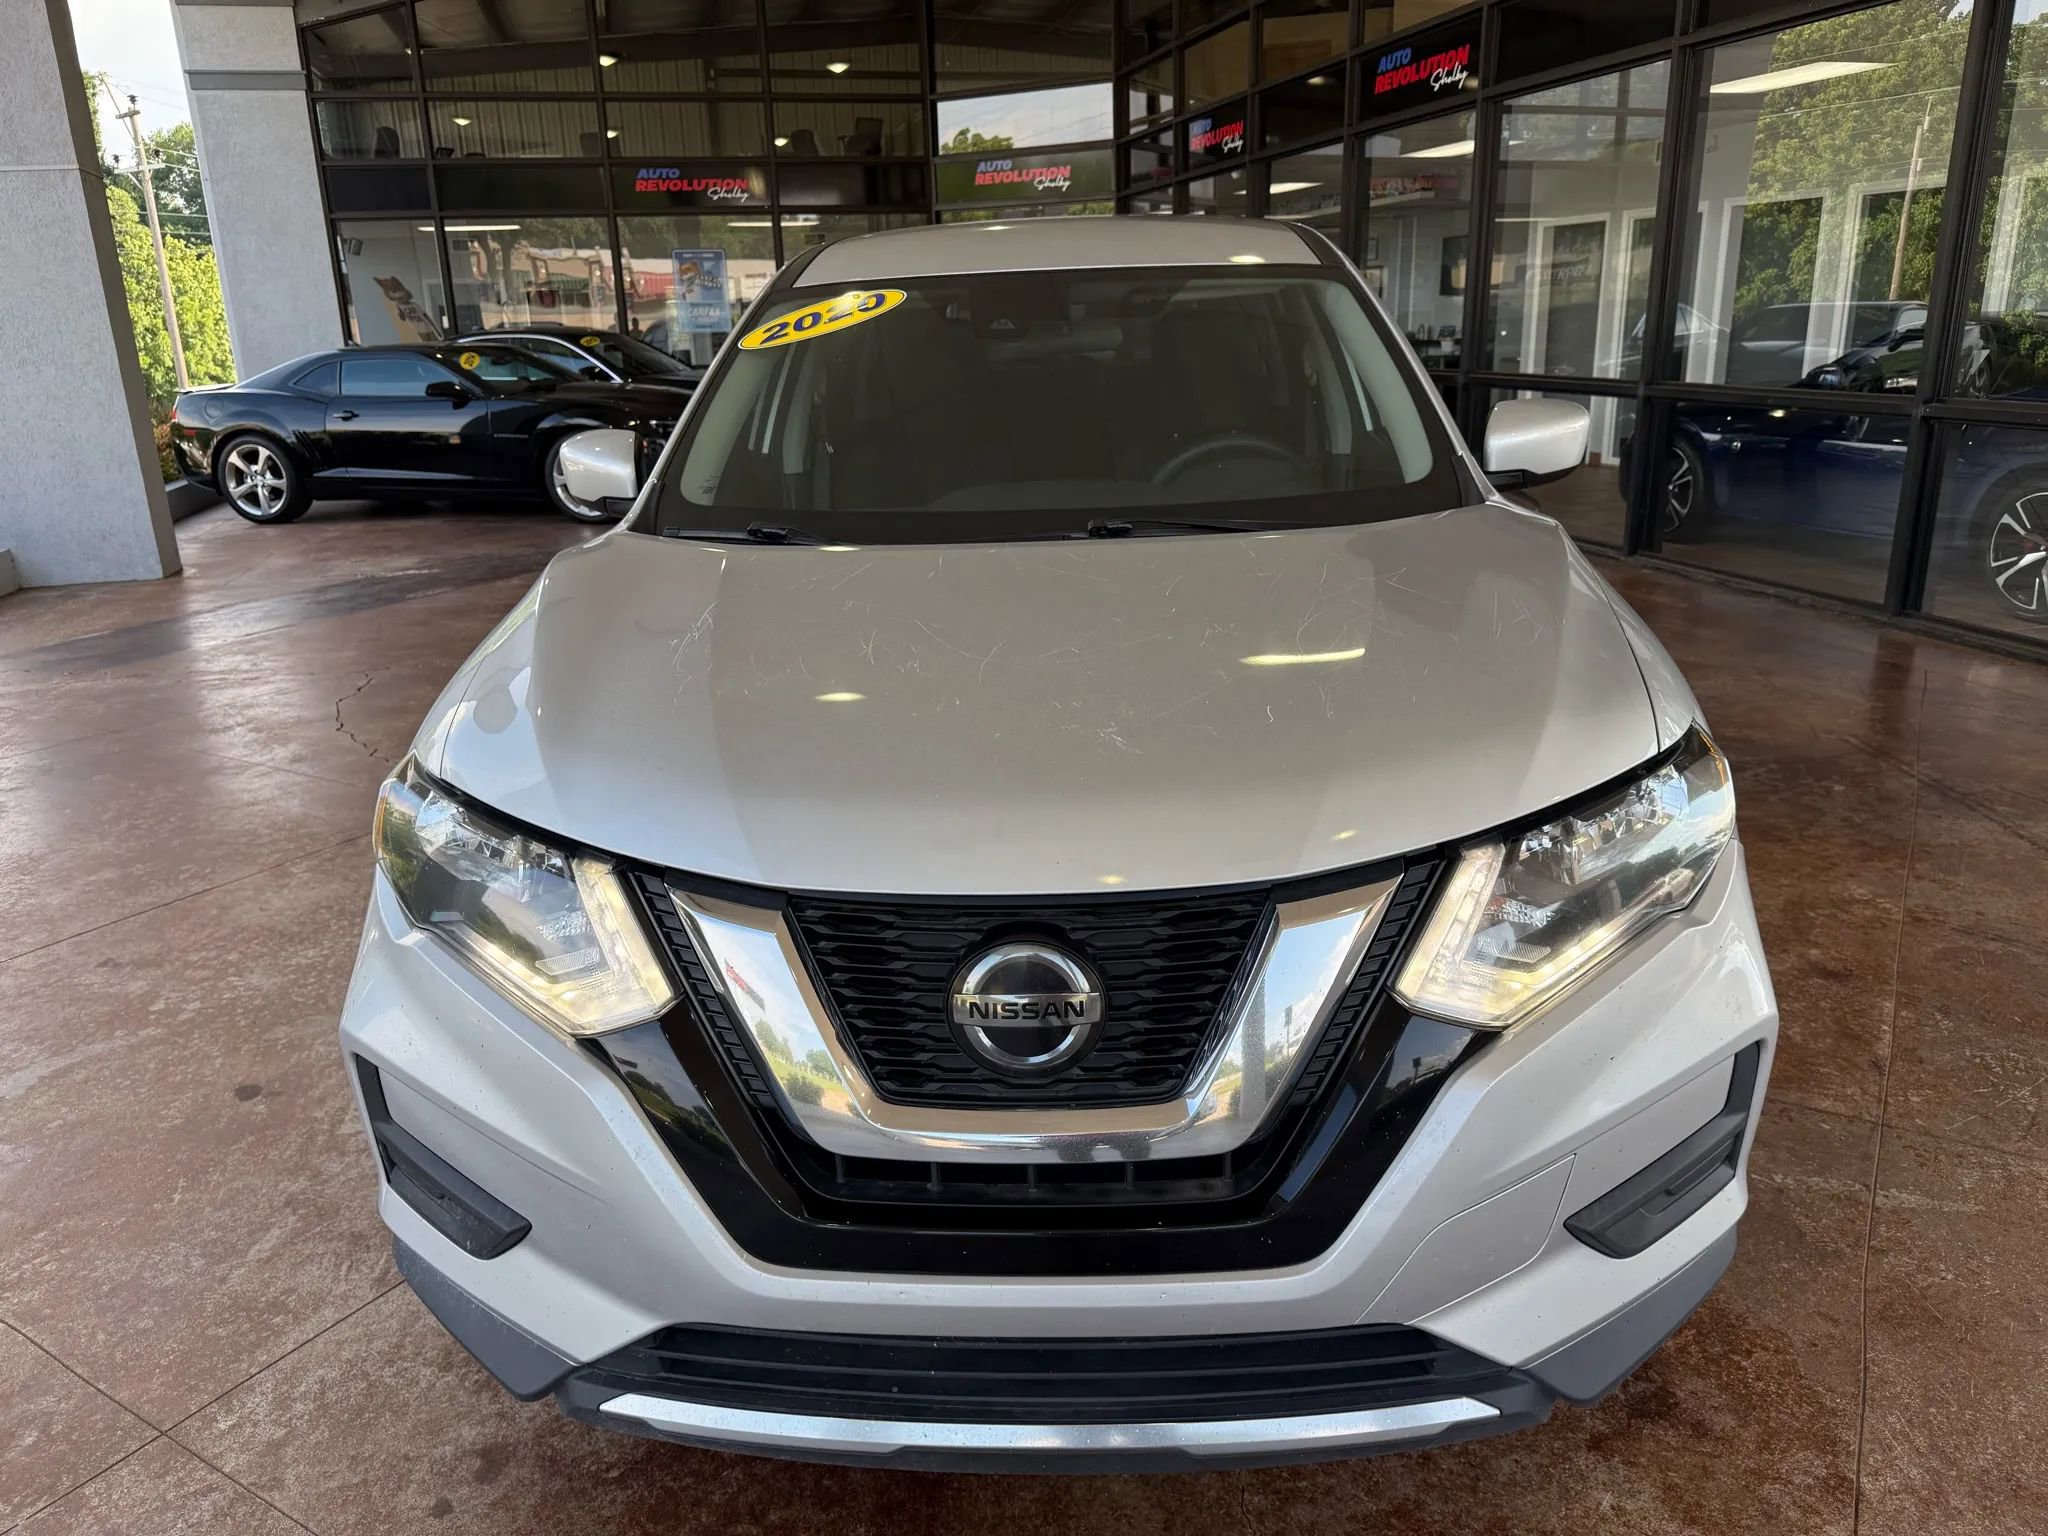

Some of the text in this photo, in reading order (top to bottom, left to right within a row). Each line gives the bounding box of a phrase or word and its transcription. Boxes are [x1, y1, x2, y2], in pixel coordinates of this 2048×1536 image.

[1374, 44, 1470, 94] REVOLUTION
[1377, 47, 1412, 73] AUTO
[1430, 61, 1469, 92] Shelby
[1190, 120, 1244, 151] REVOLUTION
[1222, 134, 1244, 153] Shelby
[637, 168, 681, 179] AUTO
[975, 165, 1072, 186] REVOLUTION
[977, 159, 1013, 173] AUTO
[634, 179, 750, 192] REVOLUTION
[1033, 175, 1072, 192] Shelby
[706, 186, 751, 203] Shelby
[759, 293, 888, 346] 2020
[968, 1000, 1086, 1020] NISSAN
